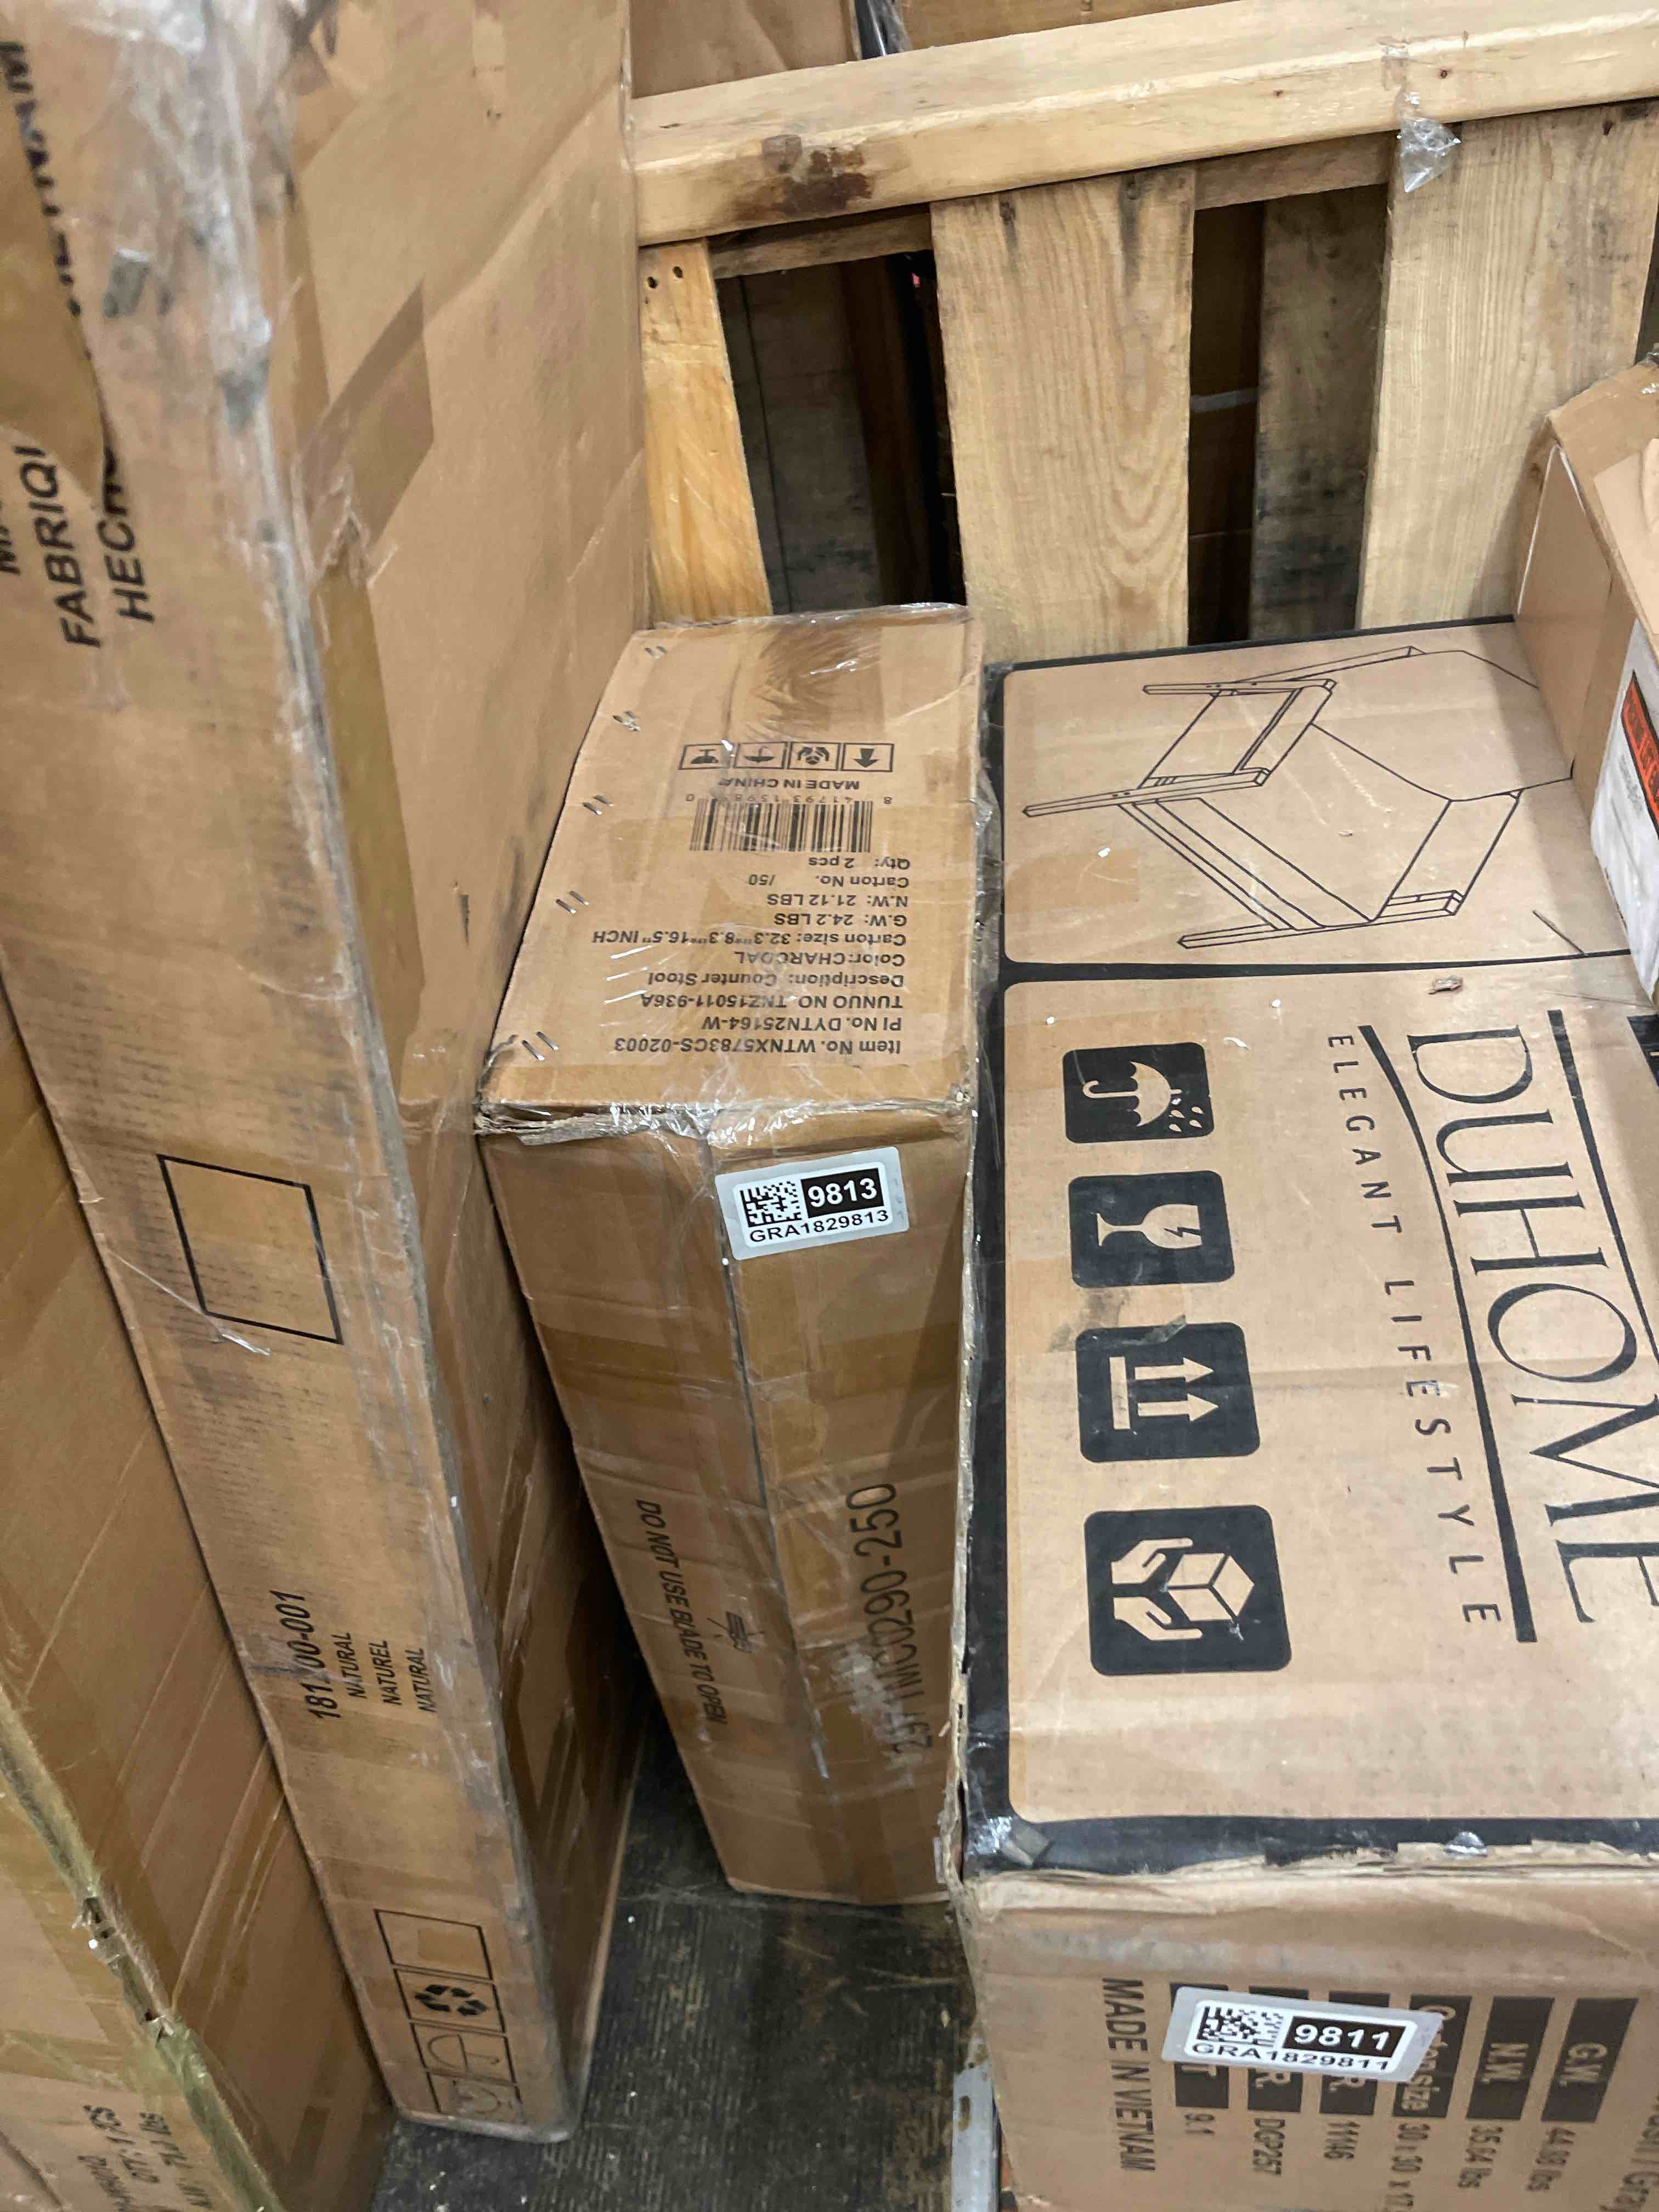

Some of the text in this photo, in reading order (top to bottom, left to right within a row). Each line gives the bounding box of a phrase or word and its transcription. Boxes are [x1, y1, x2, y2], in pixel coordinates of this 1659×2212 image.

[783, 778, 804, 790] IN
[807, 780, 860, 791] MADE
[883, 795, 893, 805] 8
[808, 856, 911, 871] Qty: 2 pcs
[748, 874, 910, 888] Carton No. /50
[766, 893, 909, 907] N.W: 21.12 LBS
[773, 913, 908, 927] G.W: 24.2 LBS
[592, 930, 638, 944] INCH
[797, 932, 840, 945] size:
[844, 933, 907, 946] Carton
[647, 971, 905, 988] Description: Counter Stool
[832, 995, 903, 1009] TUNUO
[702, 1016, 842, 1031] DYTN25164-W
[847, 1017, 878, 1032] No.
[613, 1037, 901, 1054] Item No. WTNX5783CS-02003
[807, 1177, 878, 1208] 9813
[749, 1209, 889, 1243] GRA1829813
[1328, 1034, 1502, 1624] ELEGANT LIFESTYLE
[636, 1499, 727, 1725] DO NOT USE BLADE TO OPEN
[331, 1632, 368, 1700] NATURAL
[369, 1640, 403, 1706] NATUREL
[405, 1647, 438, 1713] NATURAL
[1294, 2024, 1390, 2051] 9811
[1192, 2042, 1390, 2072] GRA1829811
[1102, 1977, 1156, 2171] MADE IN VIETNAM
